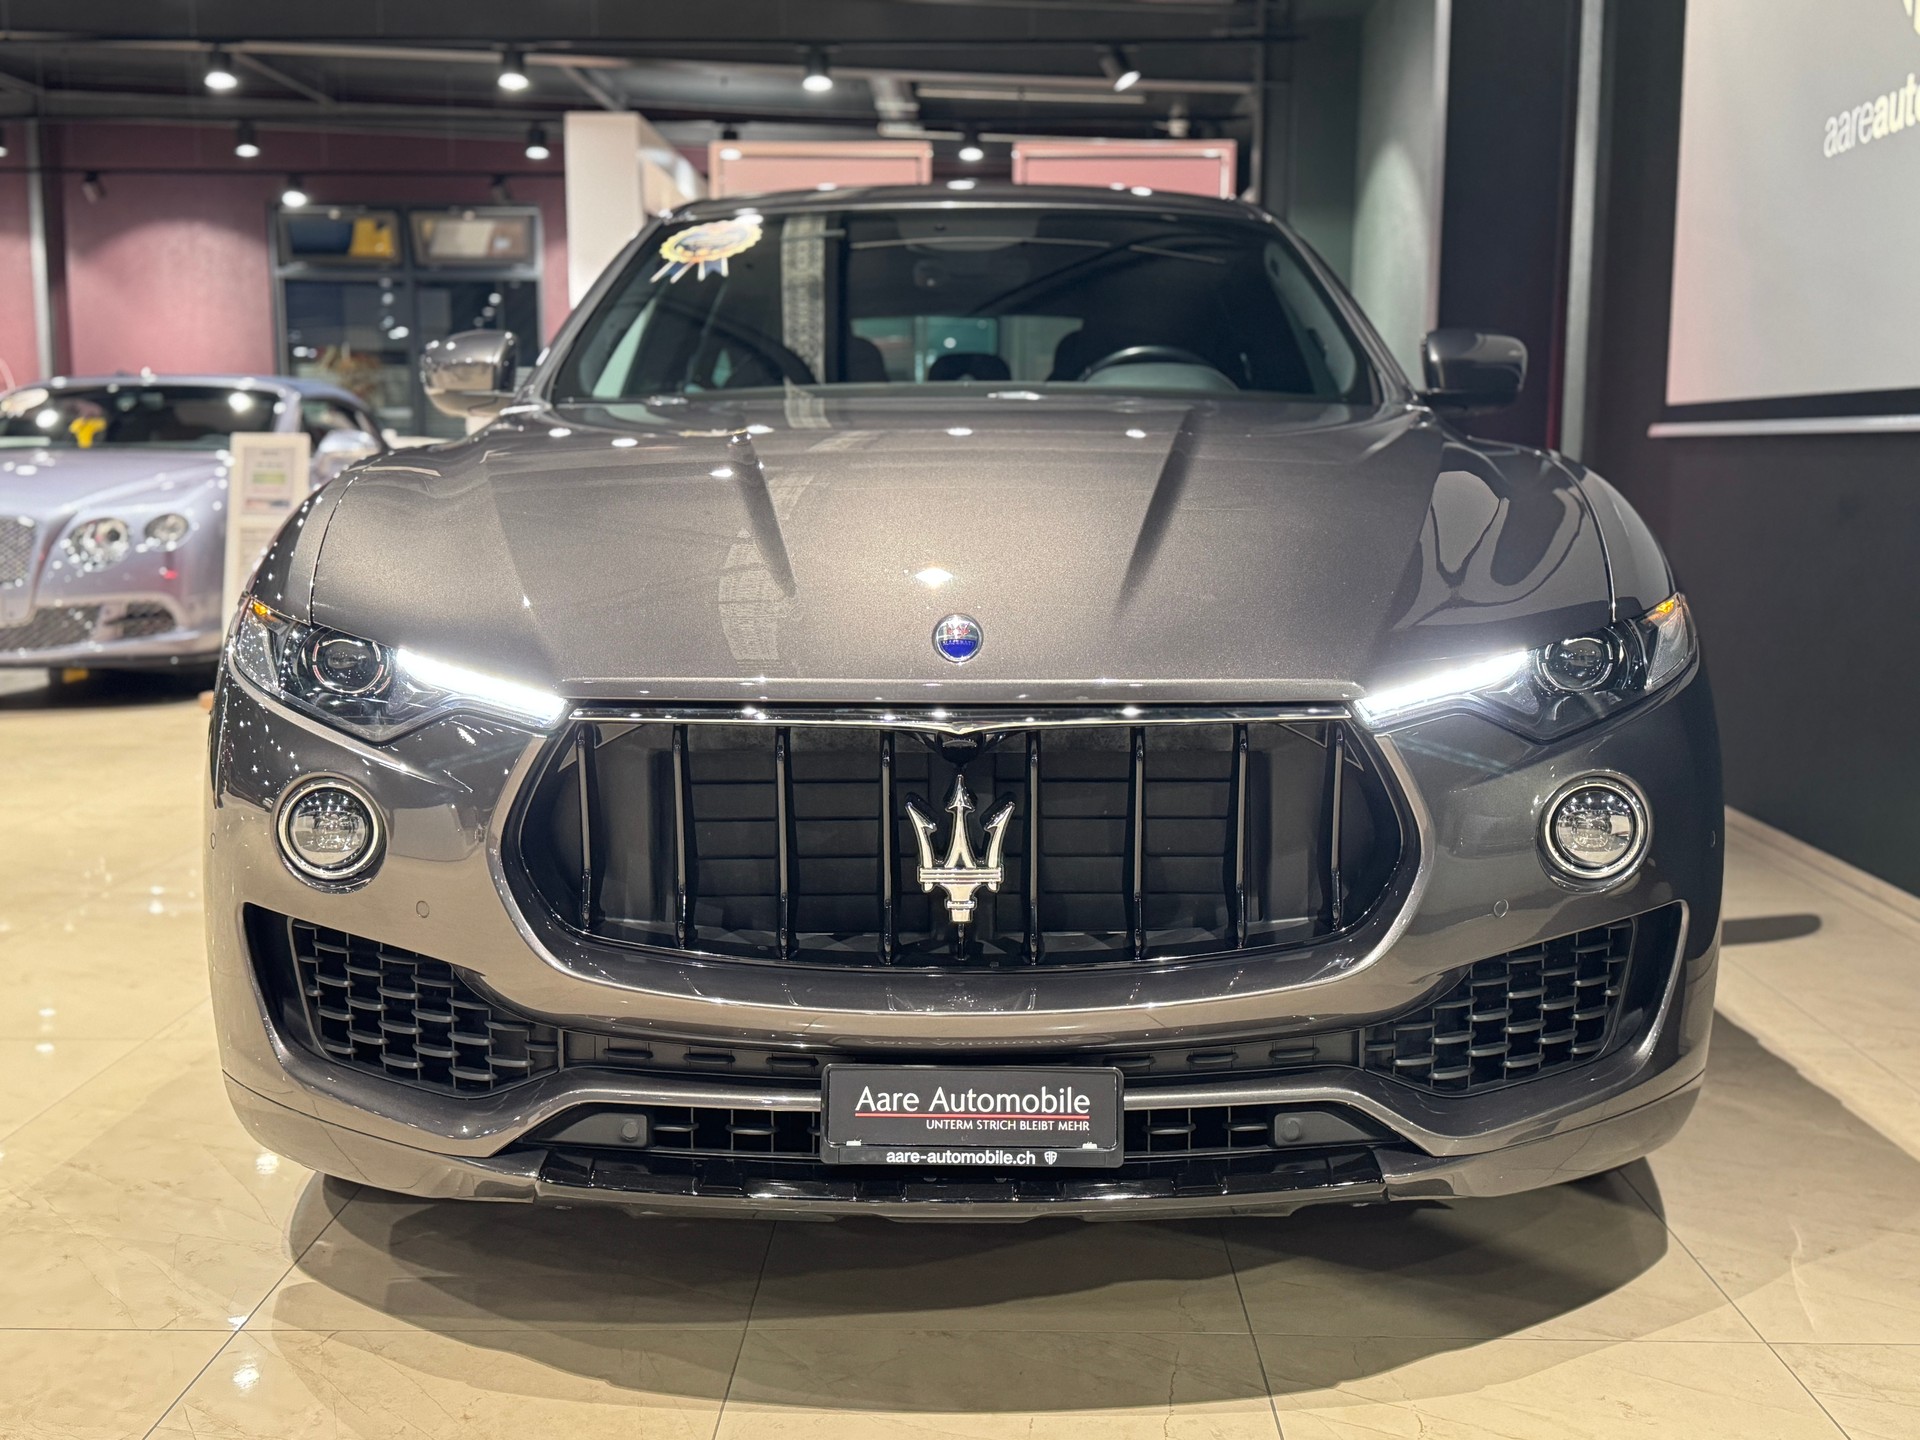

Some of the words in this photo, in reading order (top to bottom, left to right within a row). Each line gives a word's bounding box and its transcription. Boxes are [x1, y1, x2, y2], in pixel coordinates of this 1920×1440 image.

[855, 1085, 919, 1112] Aare
[928, 1086, 1090, 1114] Automobile
[926, 1119, 973, 1130] UNTERM
[977, 1120, 1016, 1130] STRICH
[1020, 1120, 1054, 1131] BLEIBT
[1058, 1121, 1090, 1131] MEHR
[886, 1150, 1035, 1165] aare-automobile.ch
